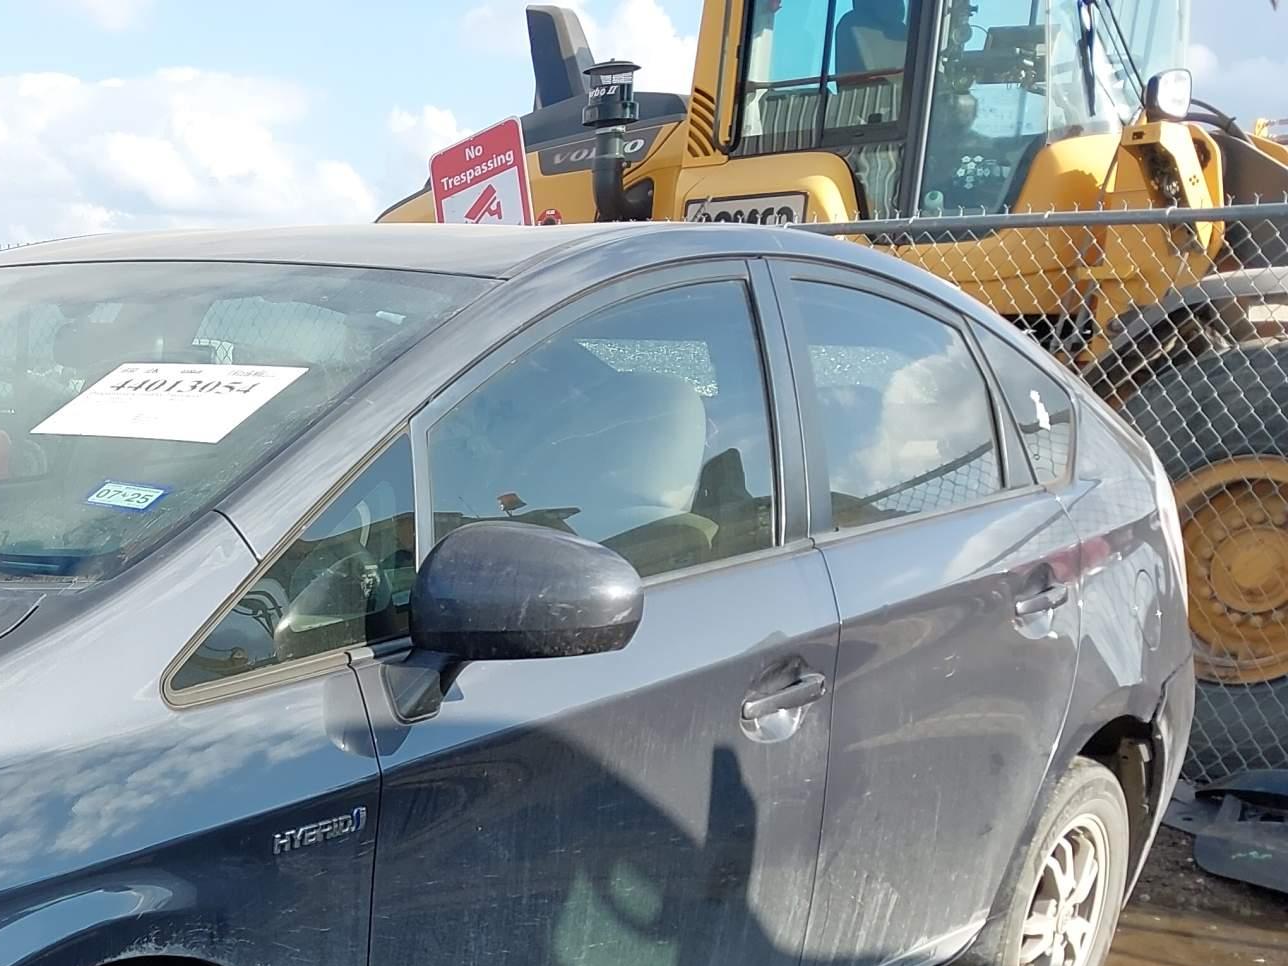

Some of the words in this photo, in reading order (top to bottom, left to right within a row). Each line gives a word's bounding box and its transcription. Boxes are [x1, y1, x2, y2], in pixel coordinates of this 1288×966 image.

[465, 145, 483, 161] No
[554, 139, 644, 164] VOLO
[441, 150, 514, 191] Trespassing
[110, 378, 261, 395] 44013054
[273, 814, 353, 855] HYBRID
